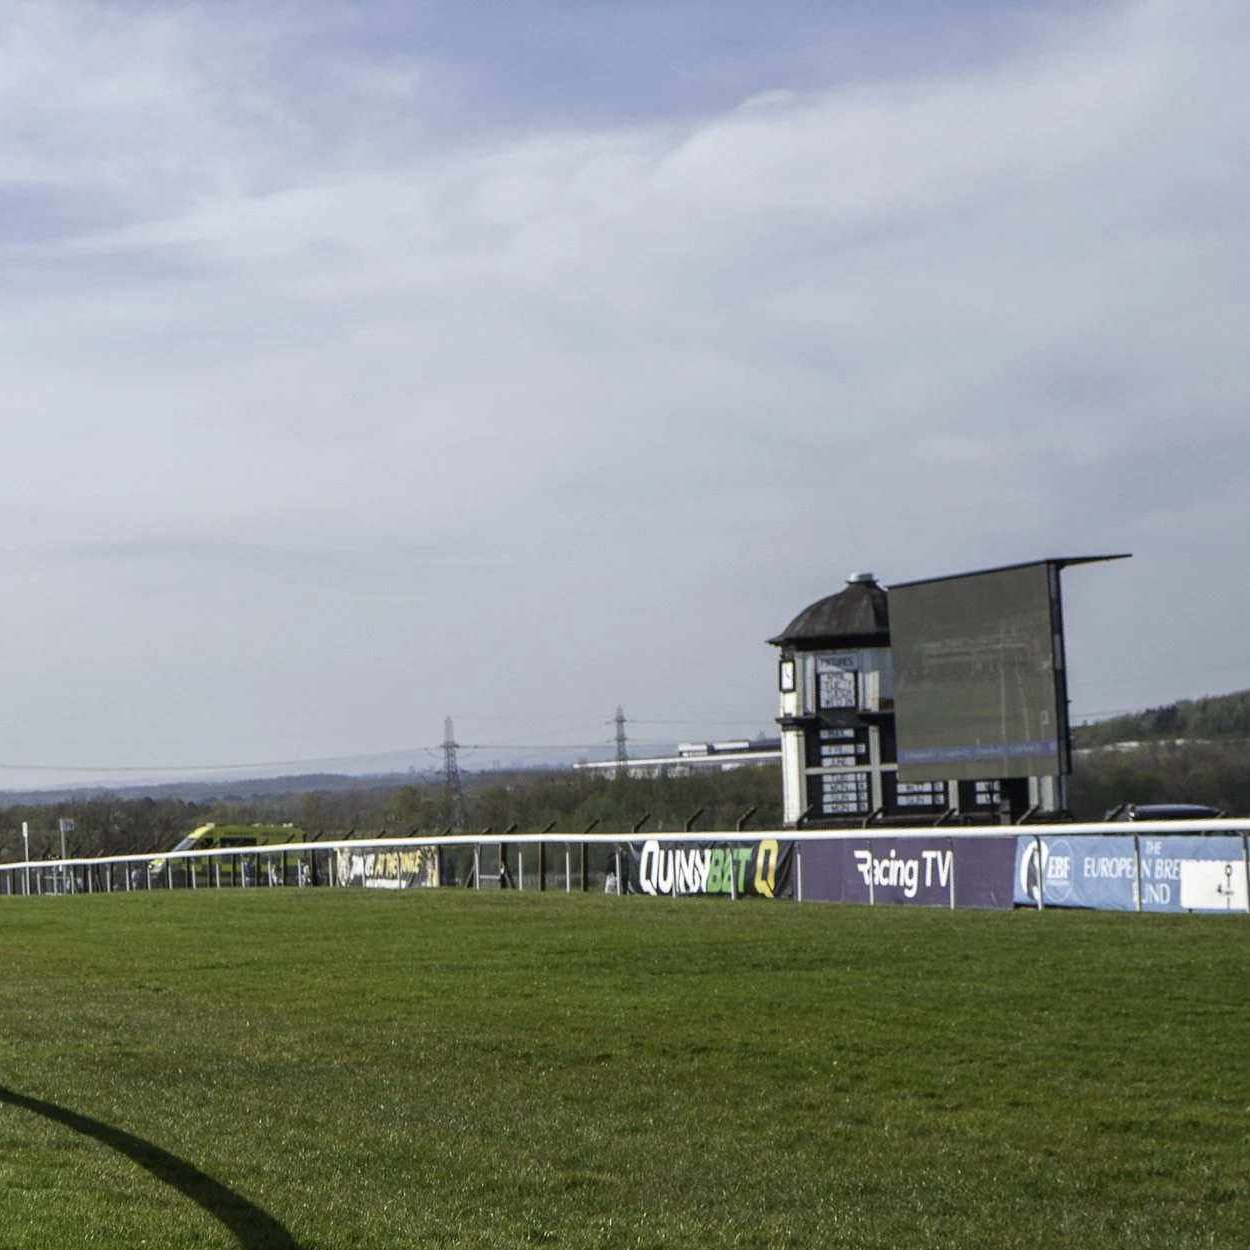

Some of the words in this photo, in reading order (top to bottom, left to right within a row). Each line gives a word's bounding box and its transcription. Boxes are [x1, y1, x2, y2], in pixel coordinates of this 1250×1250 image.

[1145, 841, 1162, 855] THE
[854, 849, 919, 898] Racing
[922, 850, 953, 887] TV
[1047, 856, 1070, 879] EBF
